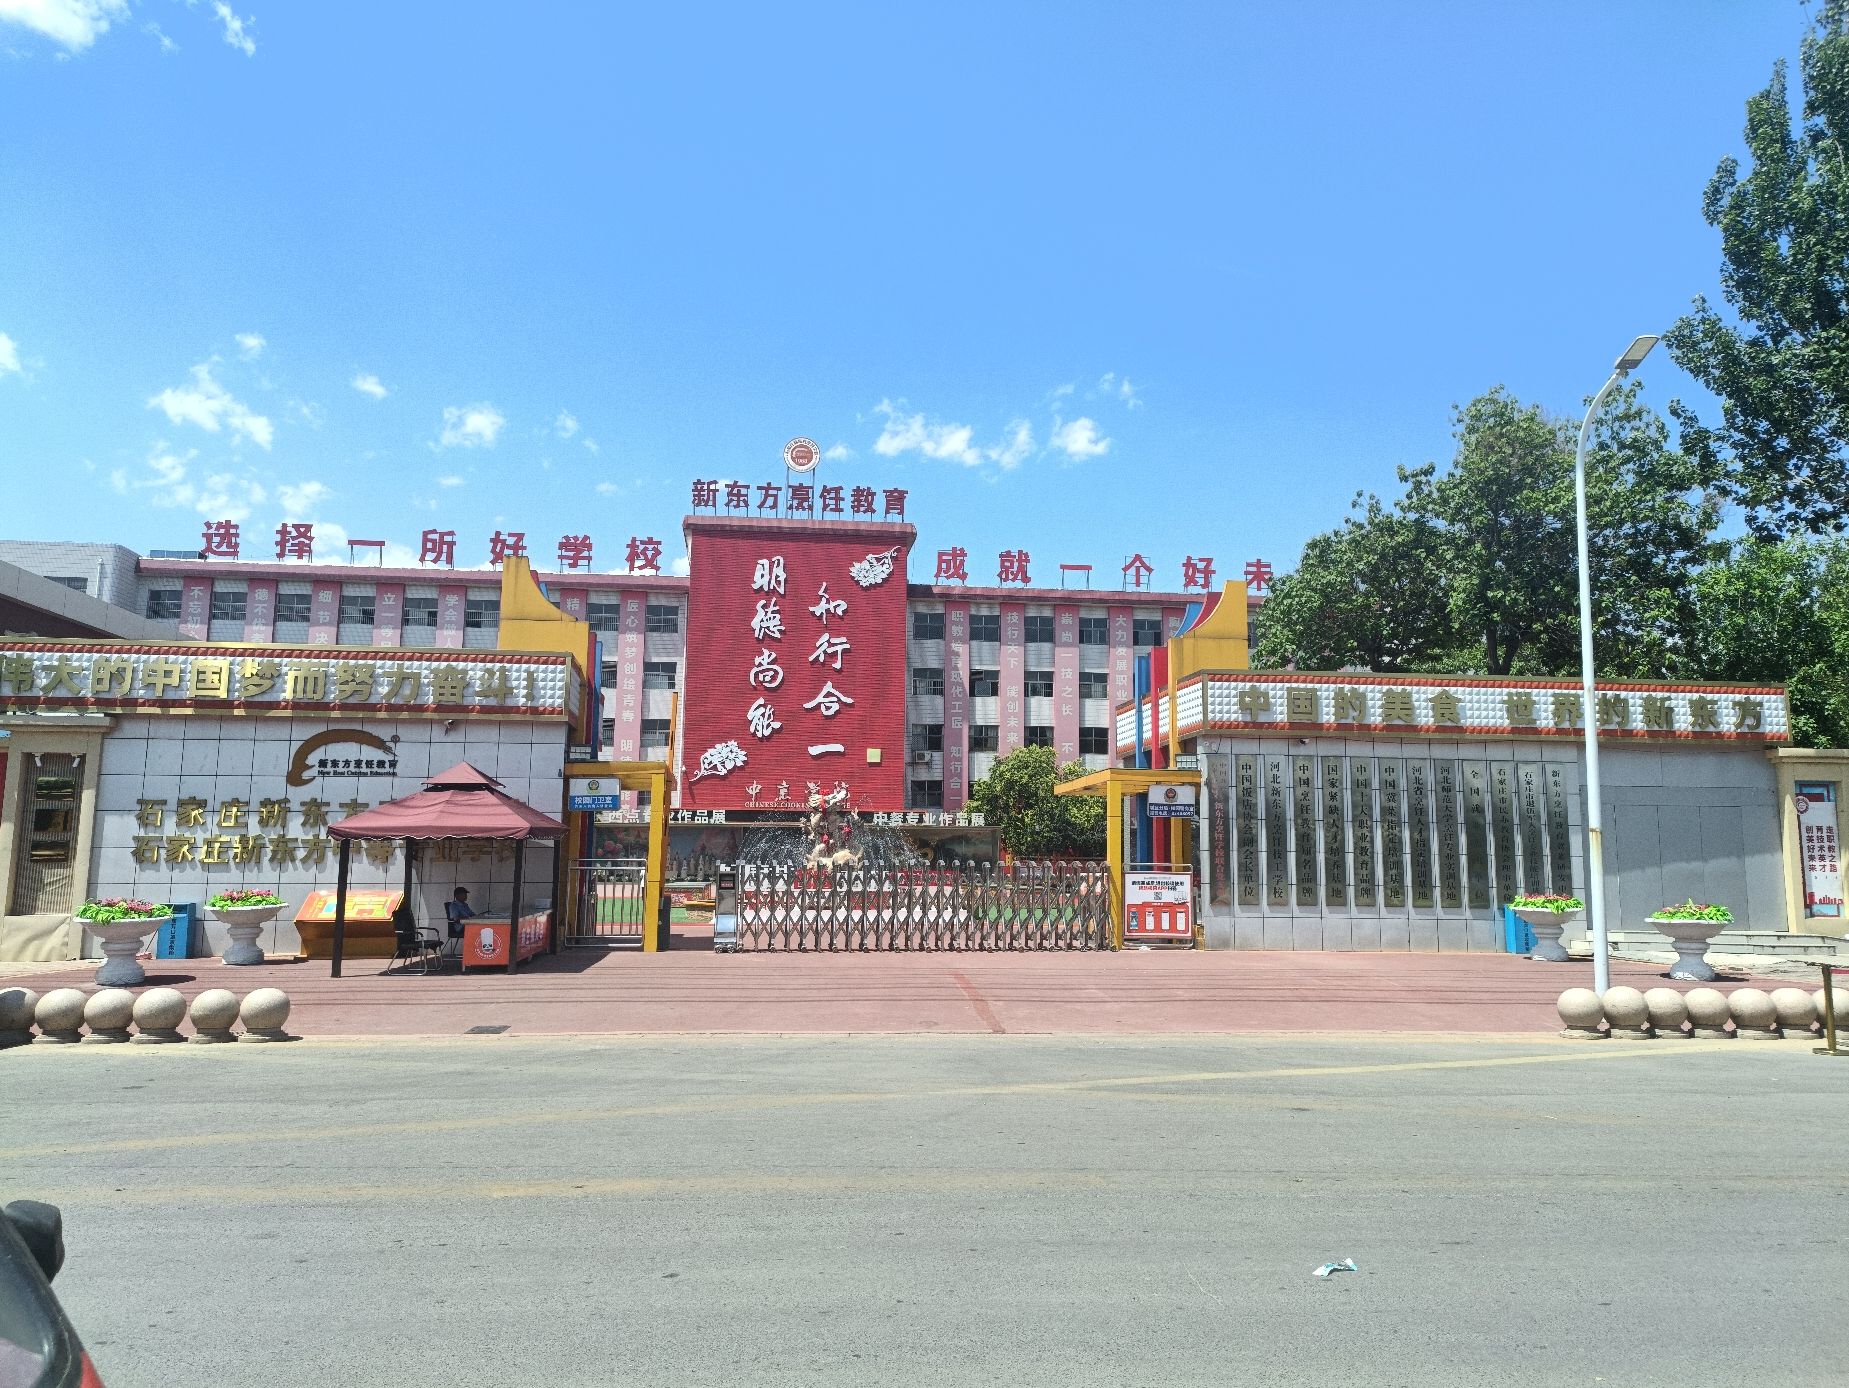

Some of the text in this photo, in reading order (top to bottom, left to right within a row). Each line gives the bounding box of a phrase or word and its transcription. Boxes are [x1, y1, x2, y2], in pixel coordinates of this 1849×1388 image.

[201, 519, 663, 572] 选择一所好学校
[691, 478, 909, 516] 新东方烹饪教育
[746, 555, 787, 738] 明德尚能
[1006, 612, 1019, 743] 技行天下 能创未来
[1060, 613, 1074, 716] 崇尚一技之长
[1114, 614, 1128, 701] 大力发展职业
[1237, 687, 1765, 731] 中国的美食 世界的新东方
[135, 797, 398, 828] 石家庄新东方
[318, 759, 399, 769] 新东方烹饪教育
[873, 811, 986, 827] 中餐专业作品展
[1241, 762, 1255, 898] 中国饭店协会副会长单位
[1270, 761, 1283, 899] 河北新东方烹饪技工学校
[1299, 763, 1313, 898] 中国烹饪教育知名品牌
[1327, 764, 1342, 898] 国家紧缺人才培养基地
[1356, 765, 1371, 899] 中国十大职业教育品牌
